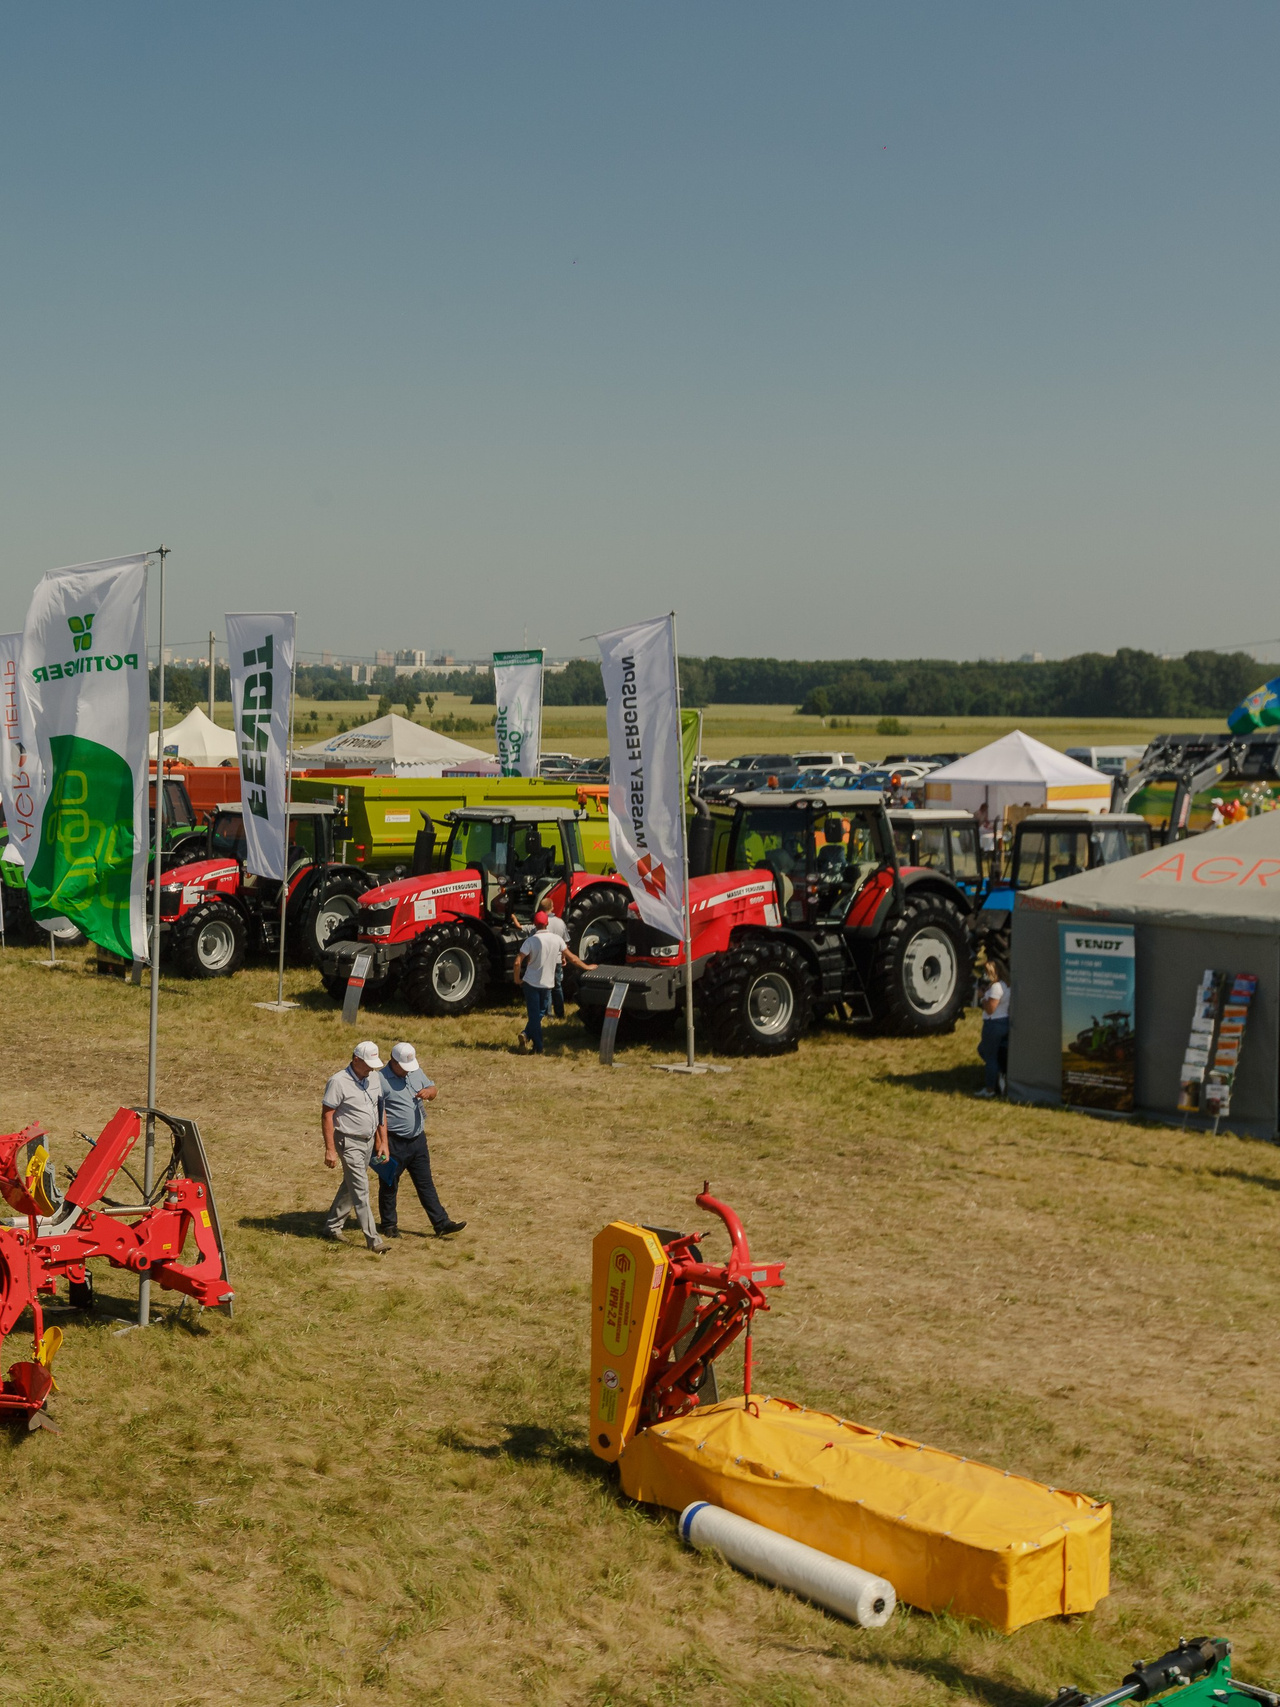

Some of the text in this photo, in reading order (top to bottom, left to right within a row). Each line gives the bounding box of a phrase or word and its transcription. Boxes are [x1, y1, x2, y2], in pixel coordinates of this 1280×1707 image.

[431, 882, 478, 895] MASSEY FERGUSON
[727, 889, 745, 899] MASSEY
[1075, 938, 1124, 951] FENDT
